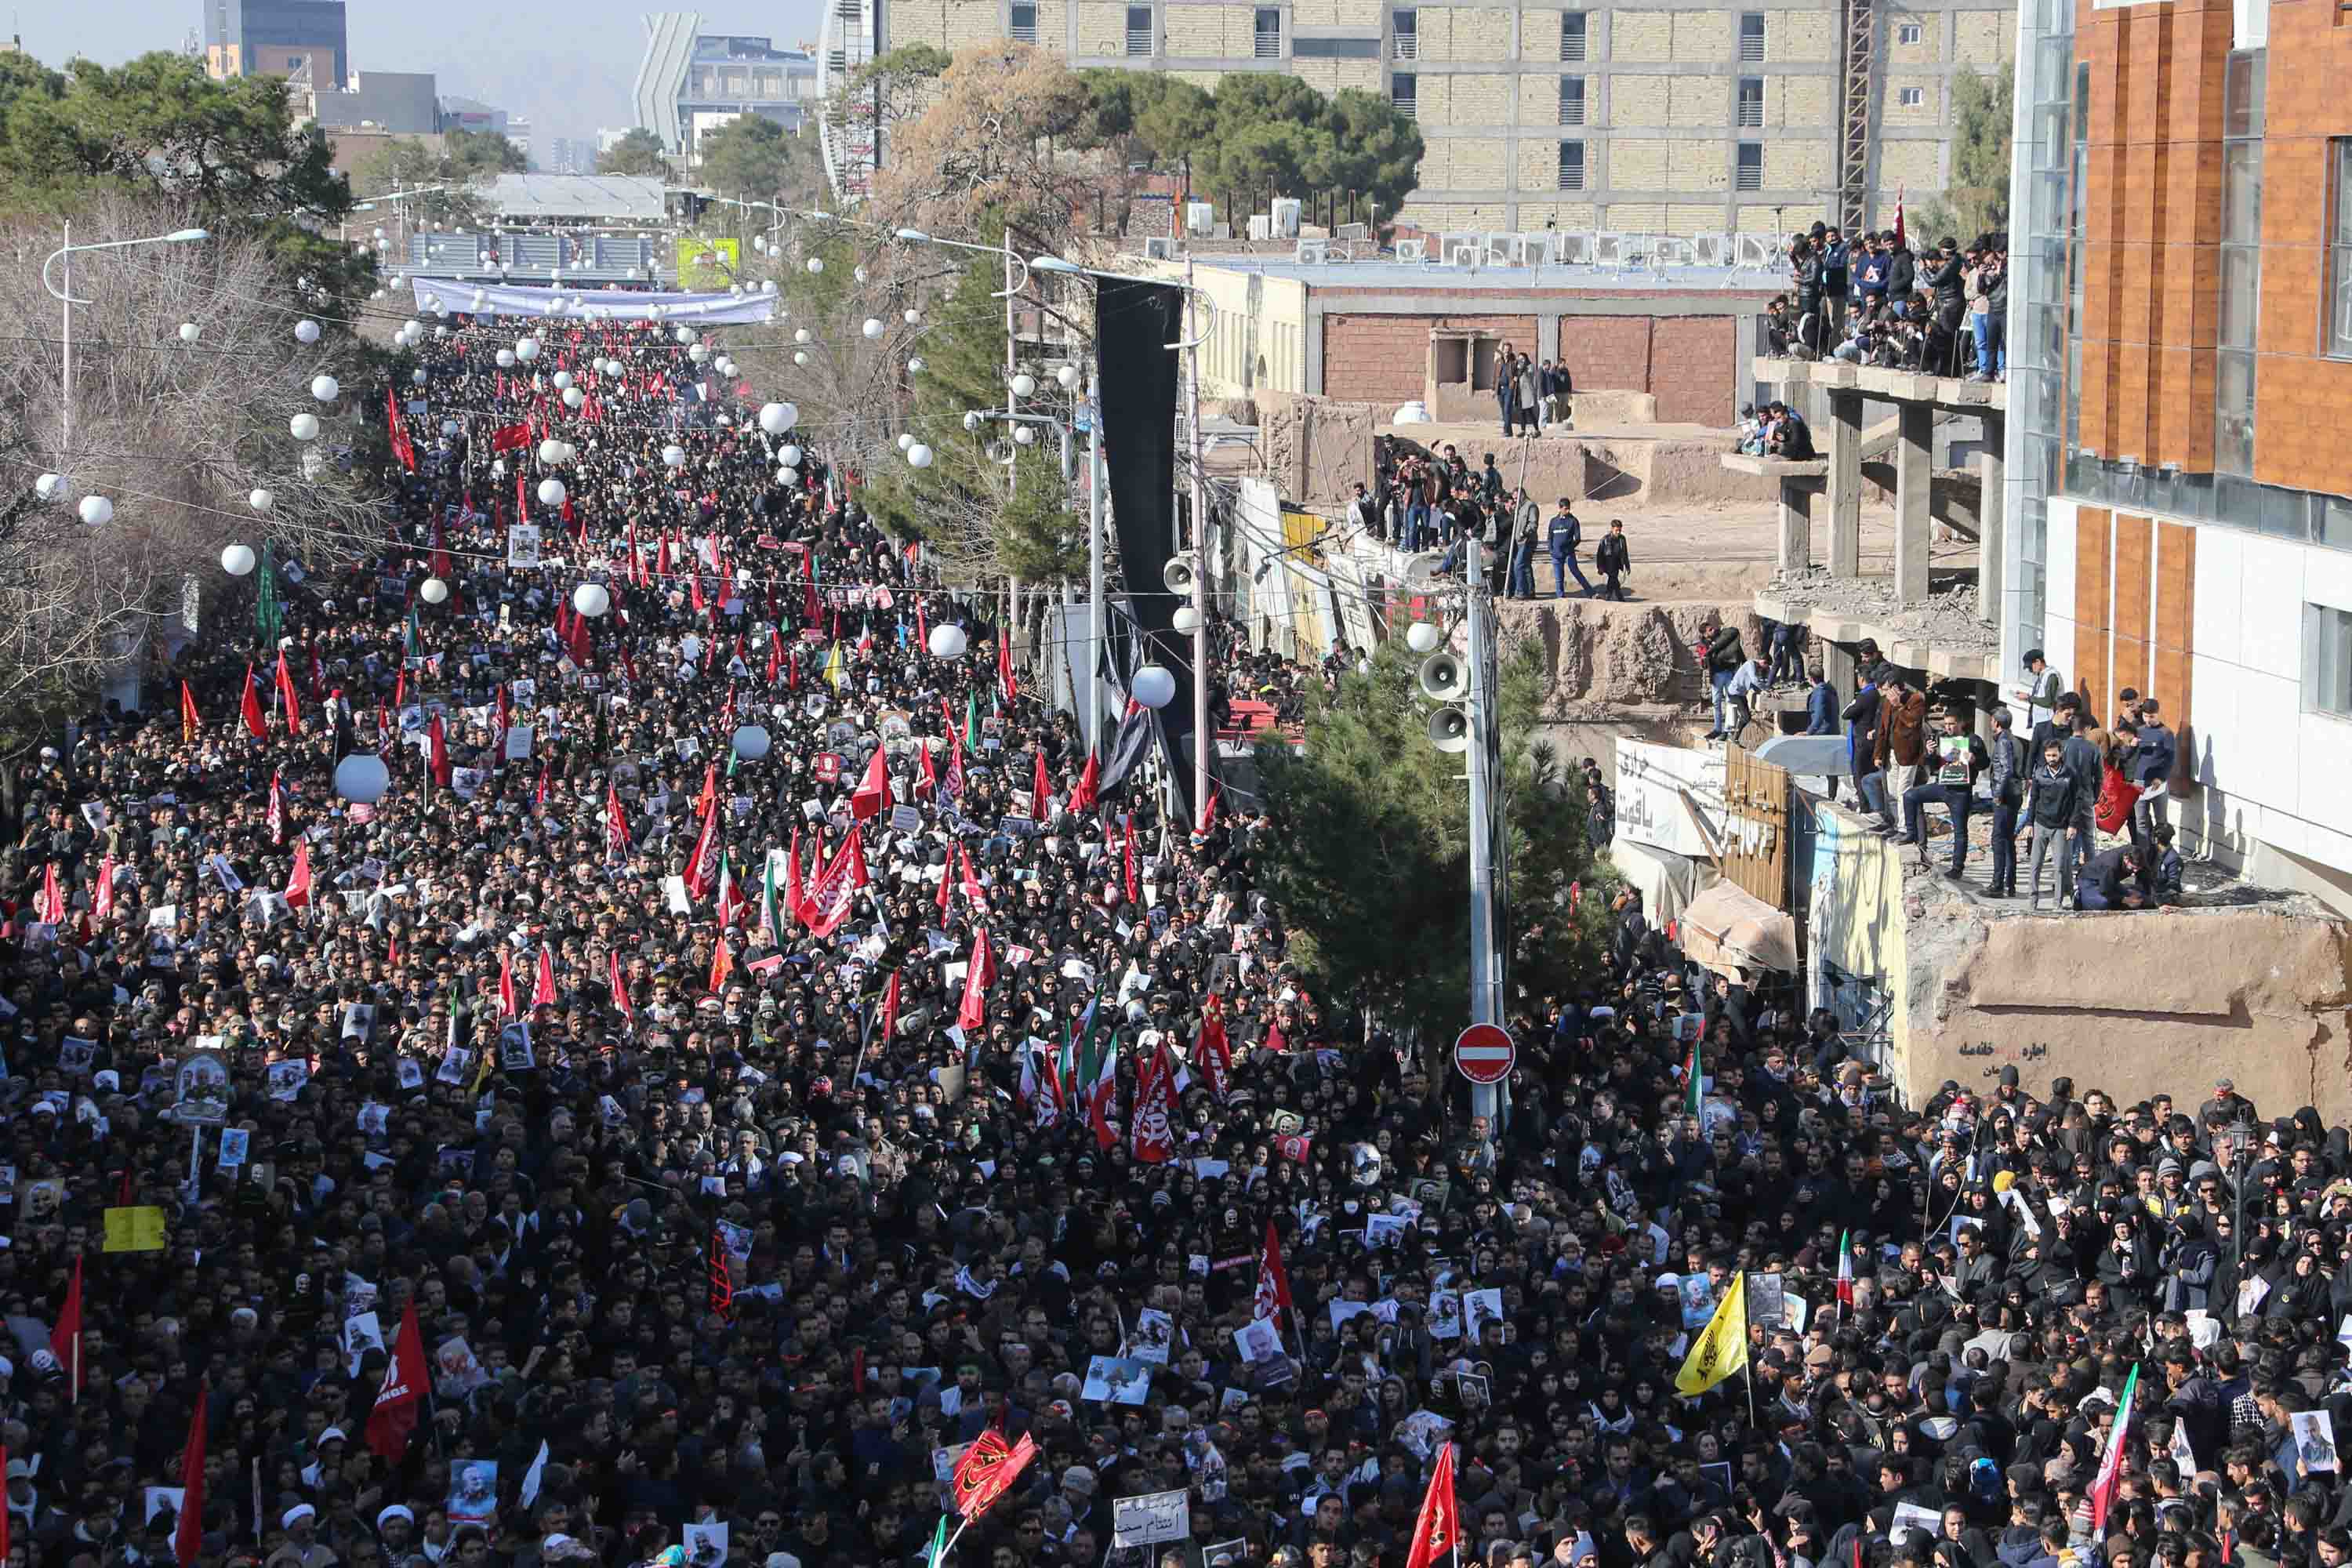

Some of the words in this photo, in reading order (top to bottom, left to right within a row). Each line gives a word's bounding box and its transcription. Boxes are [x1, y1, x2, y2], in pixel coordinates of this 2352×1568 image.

[1617, 786, 1653, 840] یاقوت
[1976, 1041, 1994, 1055] خانه
[2022, 1042, 2047, 1061] اجاره
[1115, 1523, 1142, 1536] سخت
[1145, 1512, 1179, 1542] انتقام
